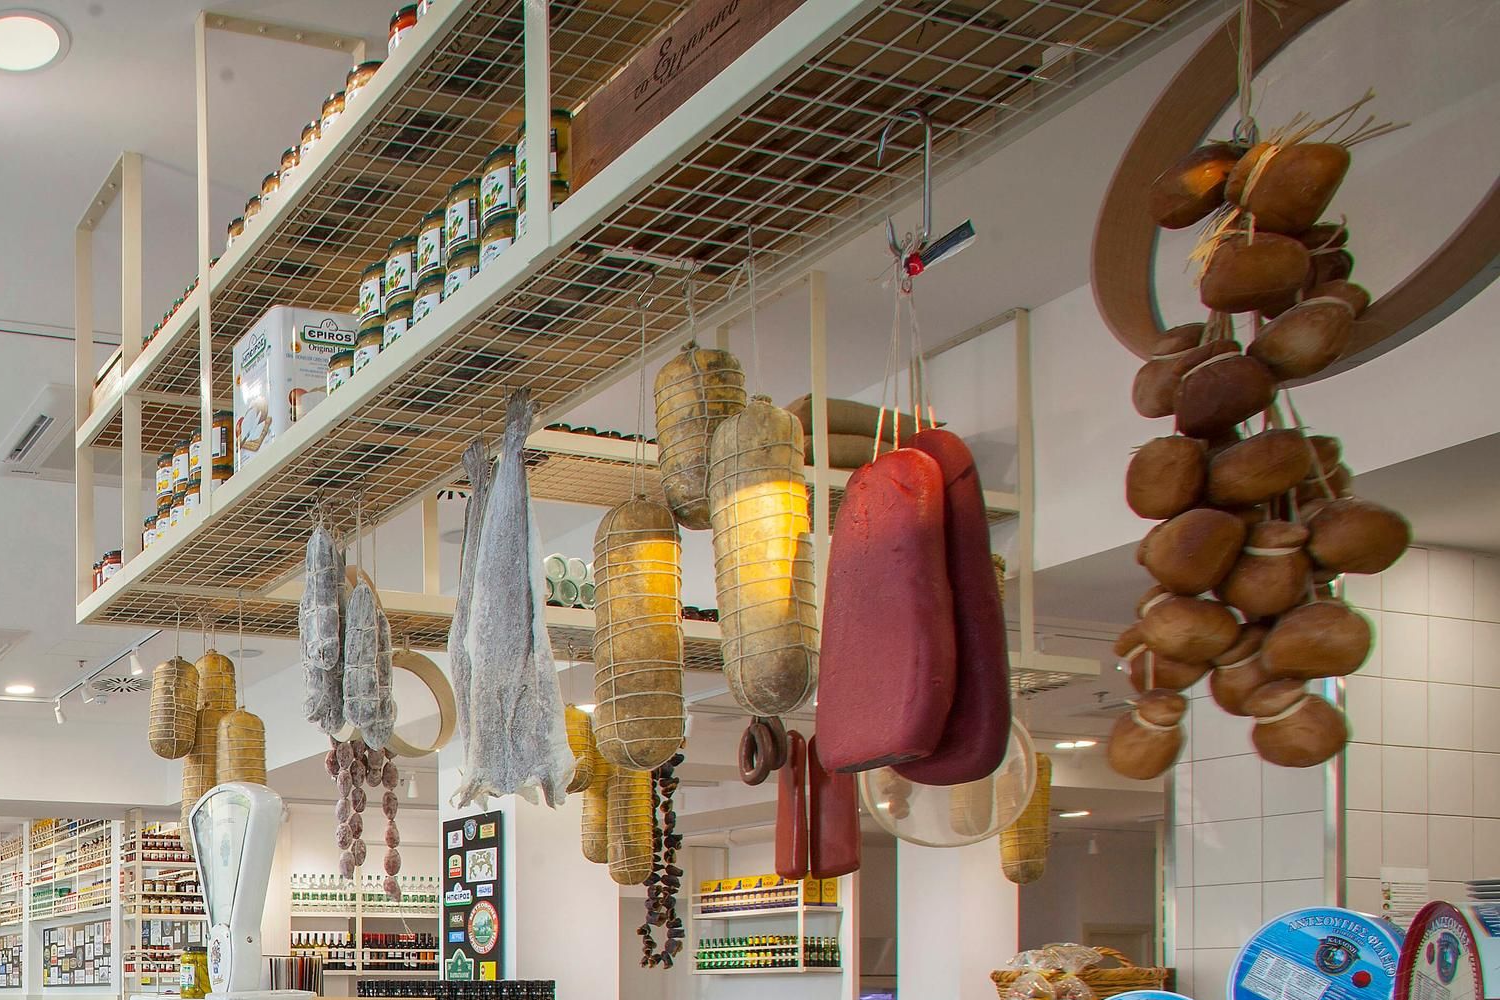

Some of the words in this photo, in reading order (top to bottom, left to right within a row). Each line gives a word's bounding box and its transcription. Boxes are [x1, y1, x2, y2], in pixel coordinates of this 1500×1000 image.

[308, 329, 352, 342] EPIROS
[308, 343, 336, 354] Original
[1288, 916, 1369, 939] ΑΝΤΣΟΥΓΙΕΣ
